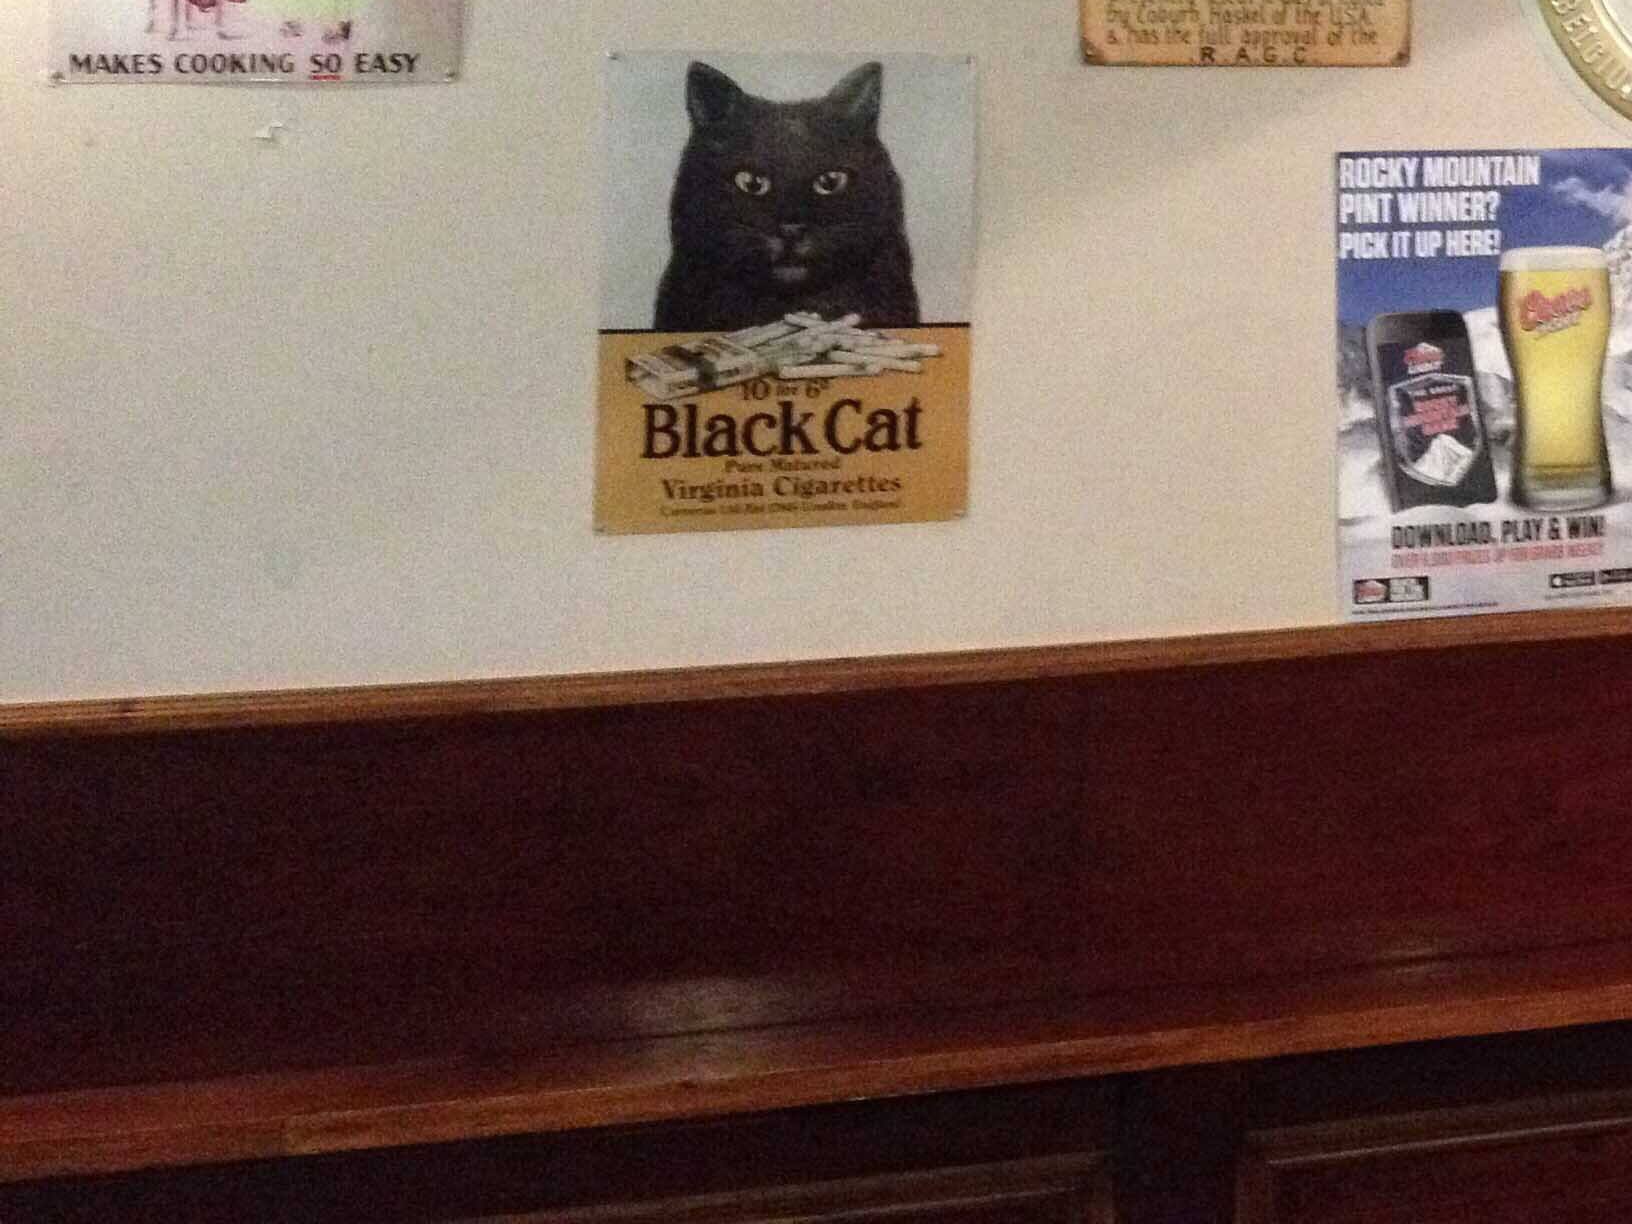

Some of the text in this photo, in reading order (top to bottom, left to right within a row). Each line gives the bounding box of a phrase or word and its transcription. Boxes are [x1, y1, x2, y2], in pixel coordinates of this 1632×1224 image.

[69, 52, 421, 75] MAKES COOKING SO EASY
[1339, 156, 1541, 189] ROCKY MOUNTAIN
[1339, 190, 1500, 223] PINT WINNER?
[1339, 231, 1390, 259] PICK
[1391, 230, 1411, 258] IT
[1414, 230, 1443, 257] UP
[640, 396, 924, 460] Black Cat
[662, 474, 902, 504] Virginia Cigarettes
[1501, 518, 1542, 543] PLAY
[1549, 516, 1561, 540] &
